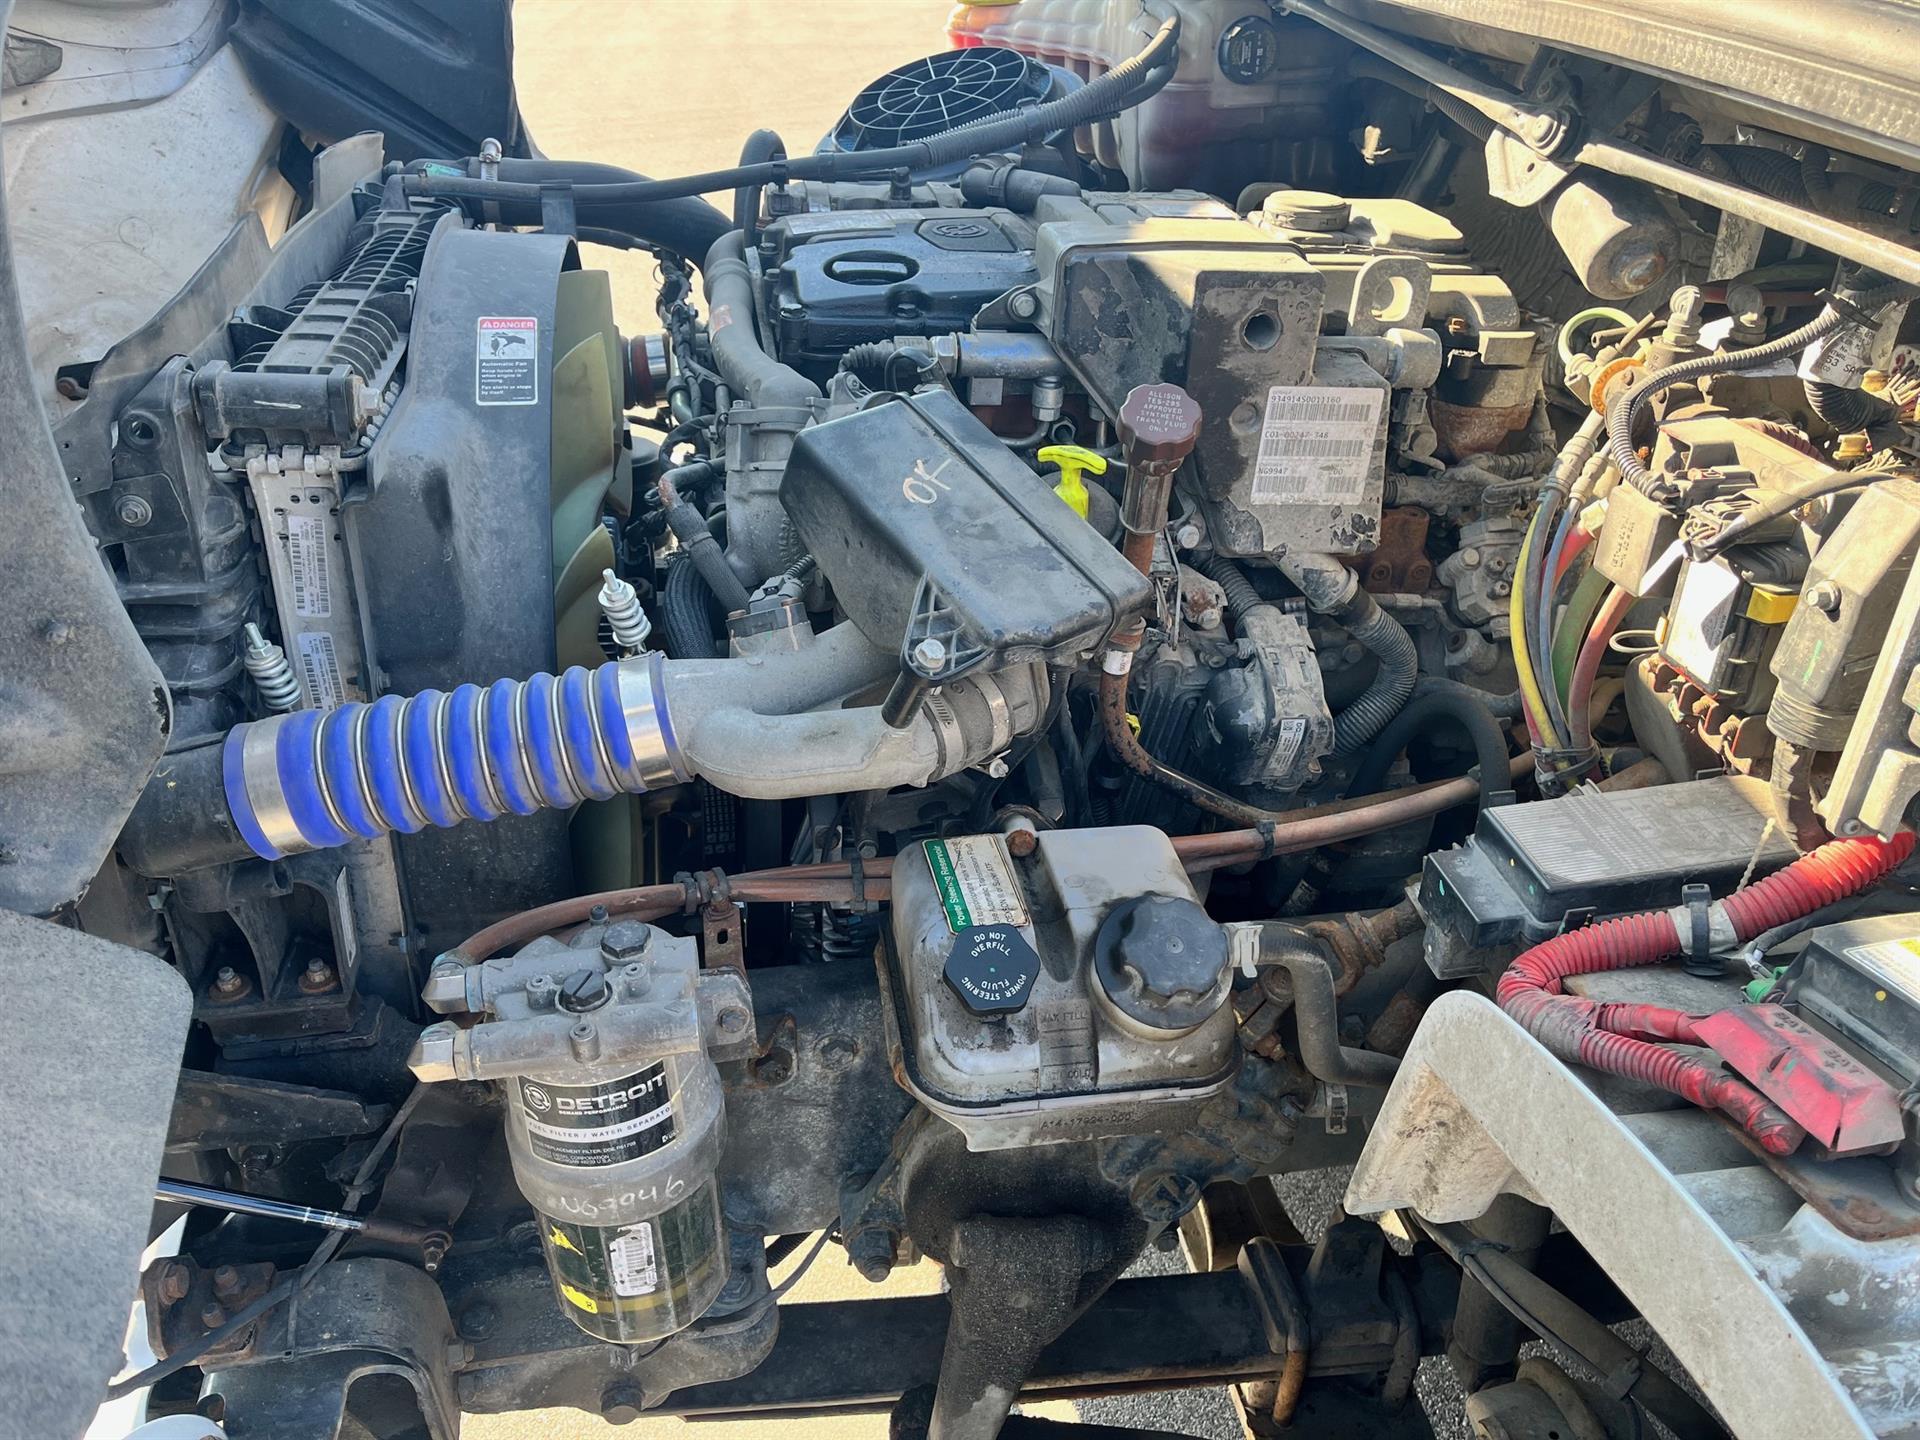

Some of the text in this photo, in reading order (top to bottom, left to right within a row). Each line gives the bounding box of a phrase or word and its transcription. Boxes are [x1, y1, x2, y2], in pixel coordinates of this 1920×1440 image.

[493, 321, 534, 329] DANGER
[1826, 355, 1840, 367] 53
[1148, 390, 1182, 400] ALLISON
[1143, 403, 1183, 414] APPROVED
[1140, 410, 1184, 421] SYNTHETIC
[1136, 415, 1187, 429] TRANS FLUID
[1148, 425, 1169, 433] ONLY
[903, 458, 952, 504] OK
[969, 855, 987, 886] Transmission
[933, 845, 967, 926] Power Steering Reservoir
[980, 886, 996, 912] Automatic
[974, 931, 1006, 943] DO NOT
[971, 941, 1012, 957] OVERFILL
[961, 973, 1027, 1001] POWER STEERING
[981, 978, 1010, 990] FLUID
[1063, 1010, 1088, 1020] FILL
[556, 1072, 666, 1111] DETROIT
[583, 1104, 628, 1115] PERFORMANCE
[528, 1121, 546, 1133] FUEL
[550, 1130, 579, 1138] FILTER
[591, 1128, 622, 1137] WATER
[627, 1106, 671, 1130] SEPARATO
